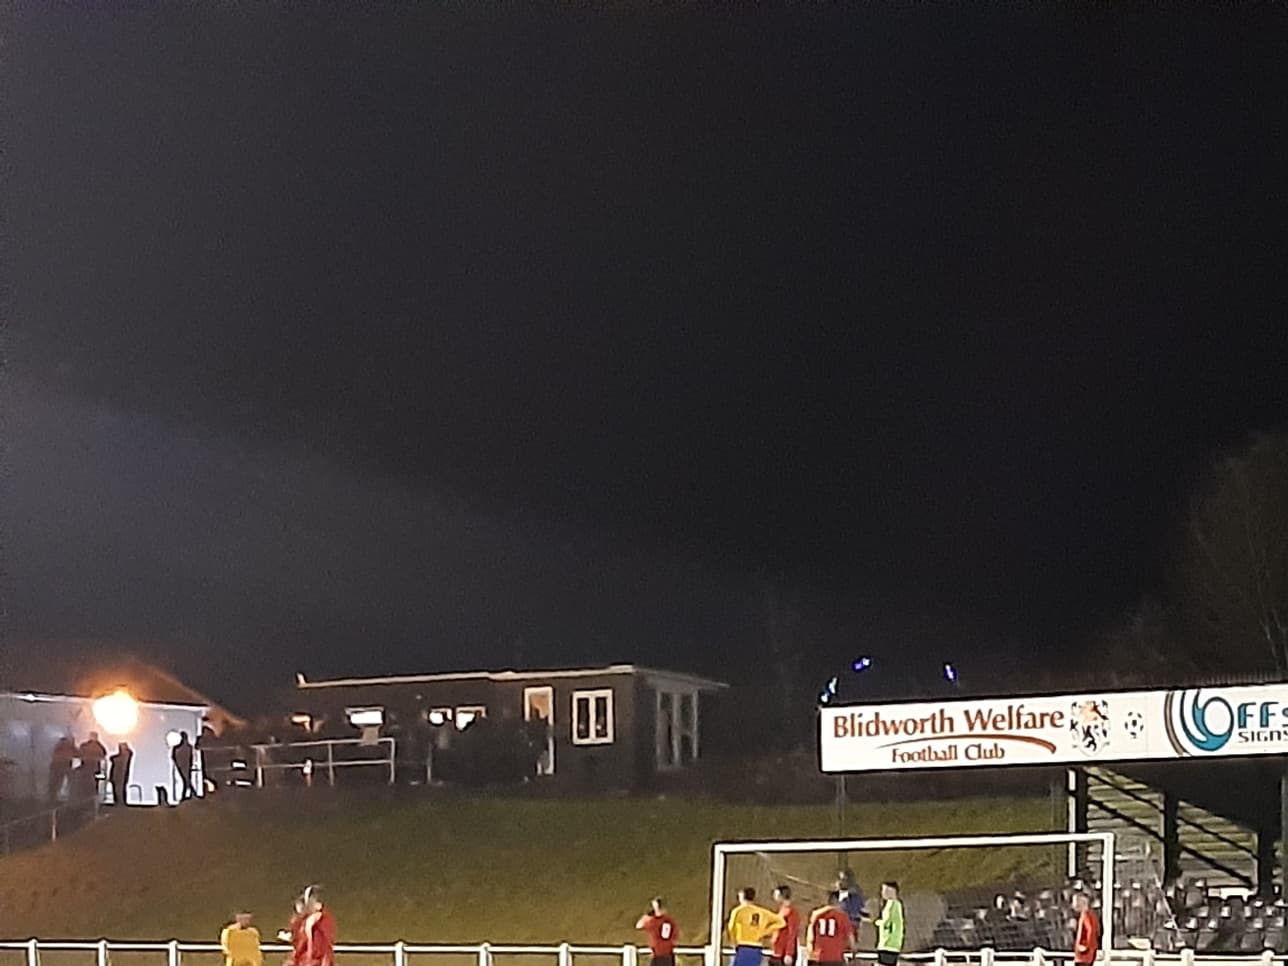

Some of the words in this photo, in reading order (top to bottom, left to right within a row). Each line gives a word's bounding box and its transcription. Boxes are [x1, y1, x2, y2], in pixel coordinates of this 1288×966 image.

[833, 709, 955, 738] Blidworth
[964, 704, 1065, 732] Welfare
[891, 743, 958, 763] Football
[964, 742, 1006, 760] Club
[819, 918, 836, 936] 11
